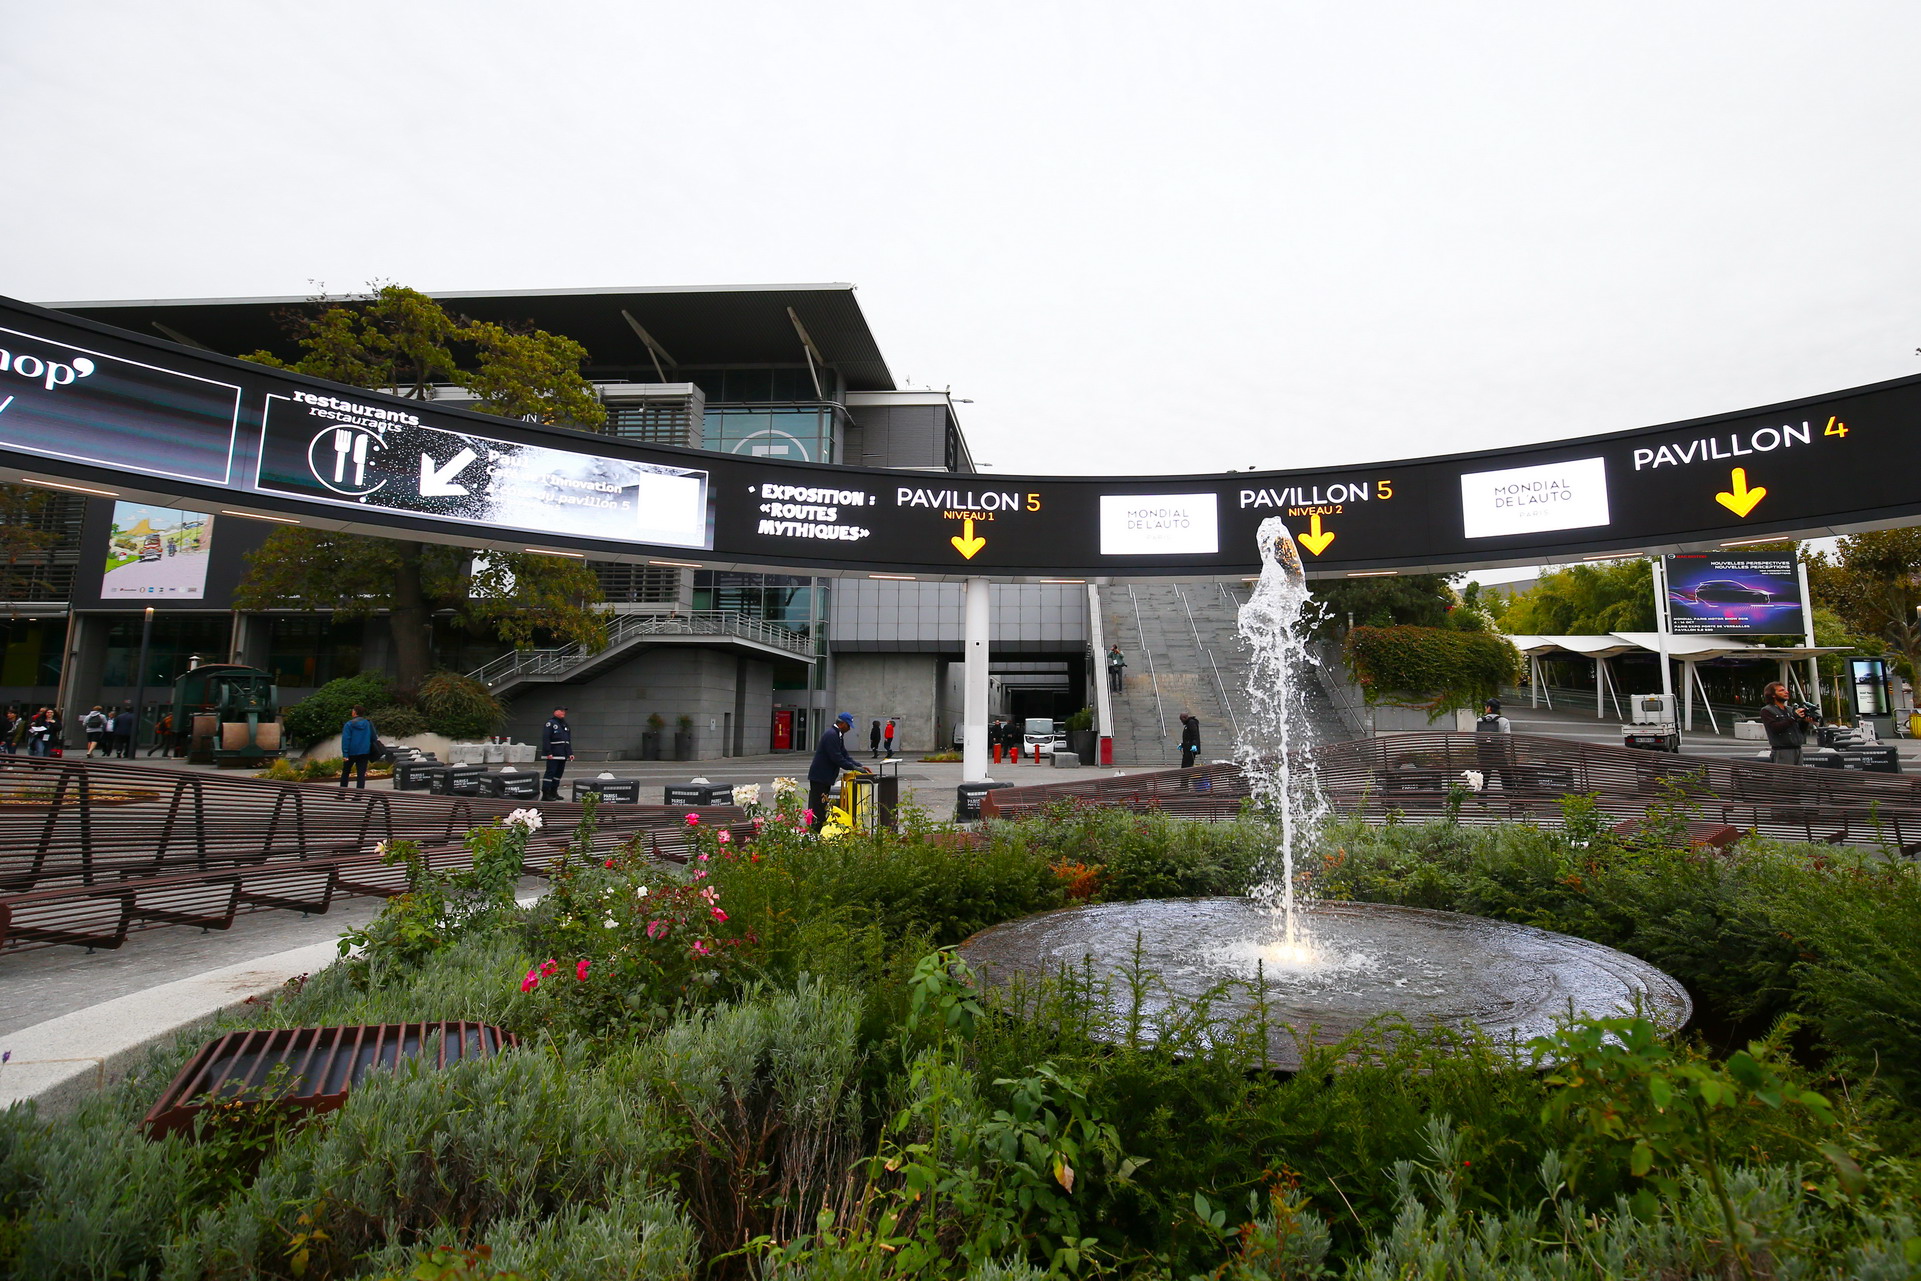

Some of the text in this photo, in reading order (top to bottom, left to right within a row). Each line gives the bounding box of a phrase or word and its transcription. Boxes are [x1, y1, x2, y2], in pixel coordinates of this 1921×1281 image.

[292, 390, 420, 426] restaurants
[1633, 415, 1849, 471] PAVILLON 4
[761, 483, 865, 507] EXPOSITION
[1239, 479, 1394, 509] PAVILLON 5
[1494, 479, 1571, 497] MONDIAL
[557, 493, 618, 510] pavillon
[620, 500, 631, 511] 5
[896, 487, 1042, 512] PAVILLON 5
[1495, 489, 1573, 509] DE L'AUTO
[759, 502, 838, 522] «ROUTES
[943, 510, 995, 521] NIVEAU 1
[1127, 508, 1189, 519] MONDIAL
[1287, 504, 1344, 518] NIVEAU 2
[757, 520, 871, 541] MYTHIQUES»
[1127, 519, 1143, 530] DE
